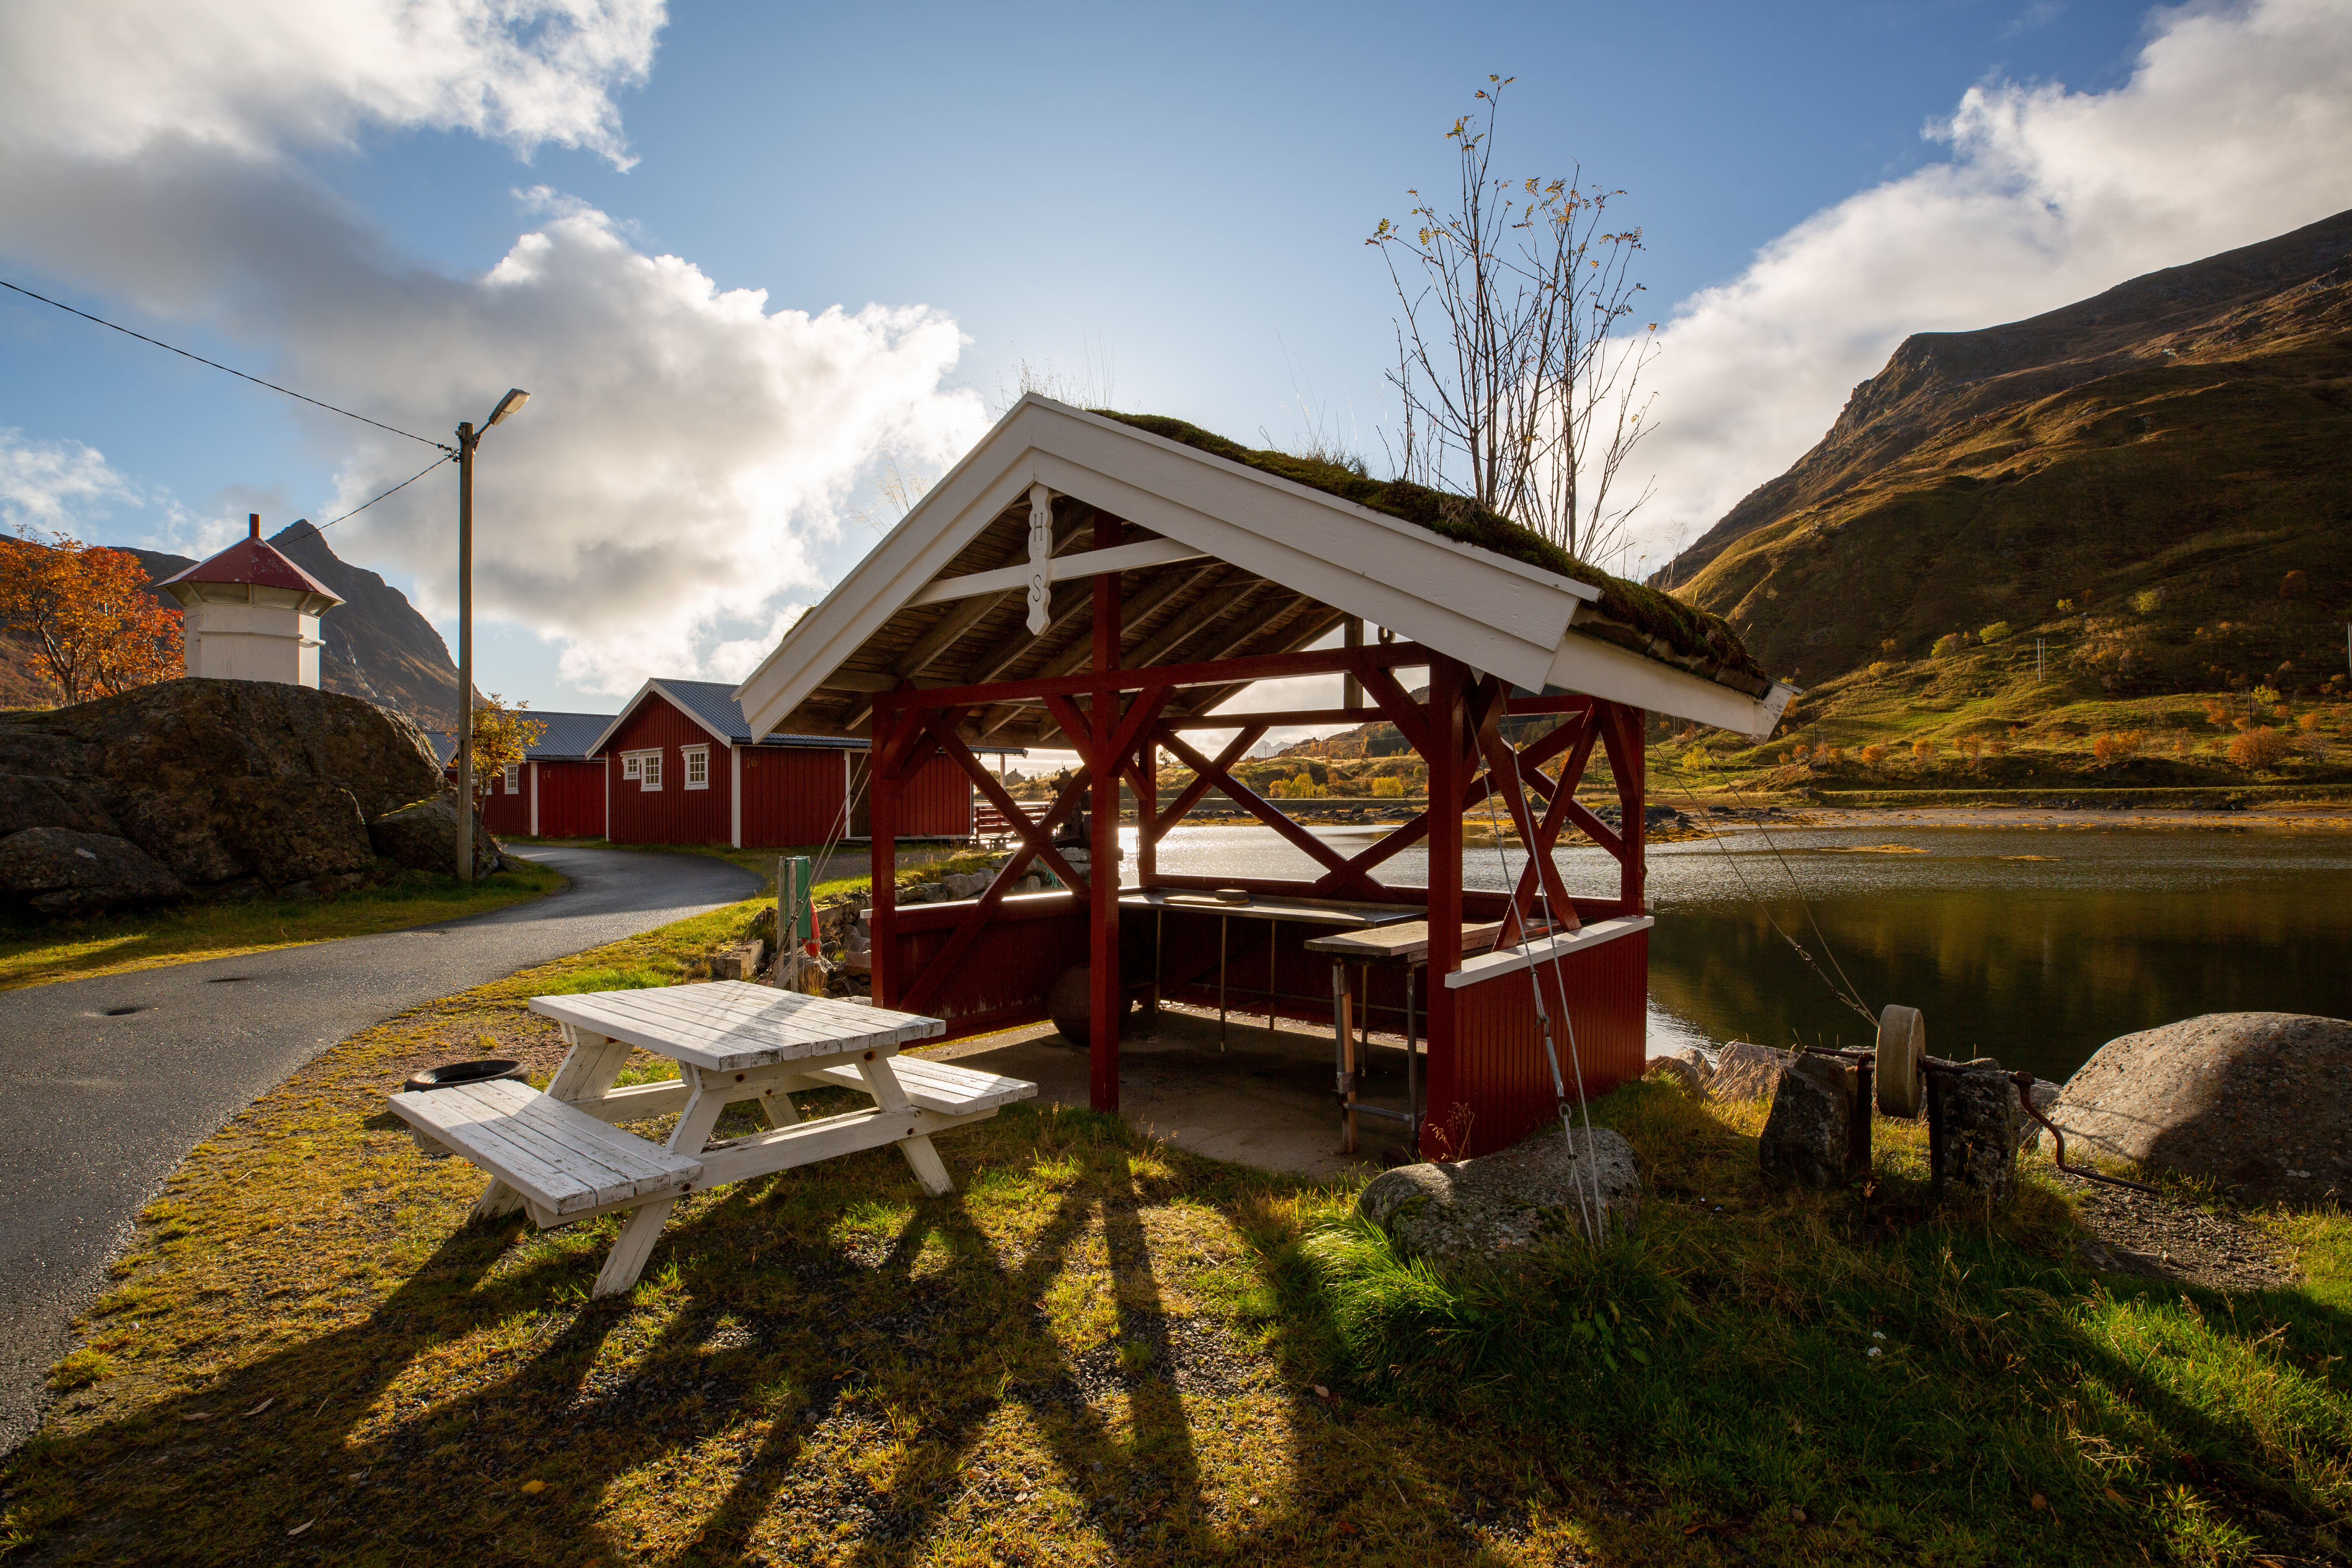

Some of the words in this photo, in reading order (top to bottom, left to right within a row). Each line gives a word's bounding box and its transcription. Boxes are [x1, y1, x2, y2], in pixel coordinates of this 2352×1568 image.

[1033, 512, 1043, 542] H
[1032, 574, 1042, 602] S
[747, 757, 757, 768] 16
[543, 770, 551, 779] 17
